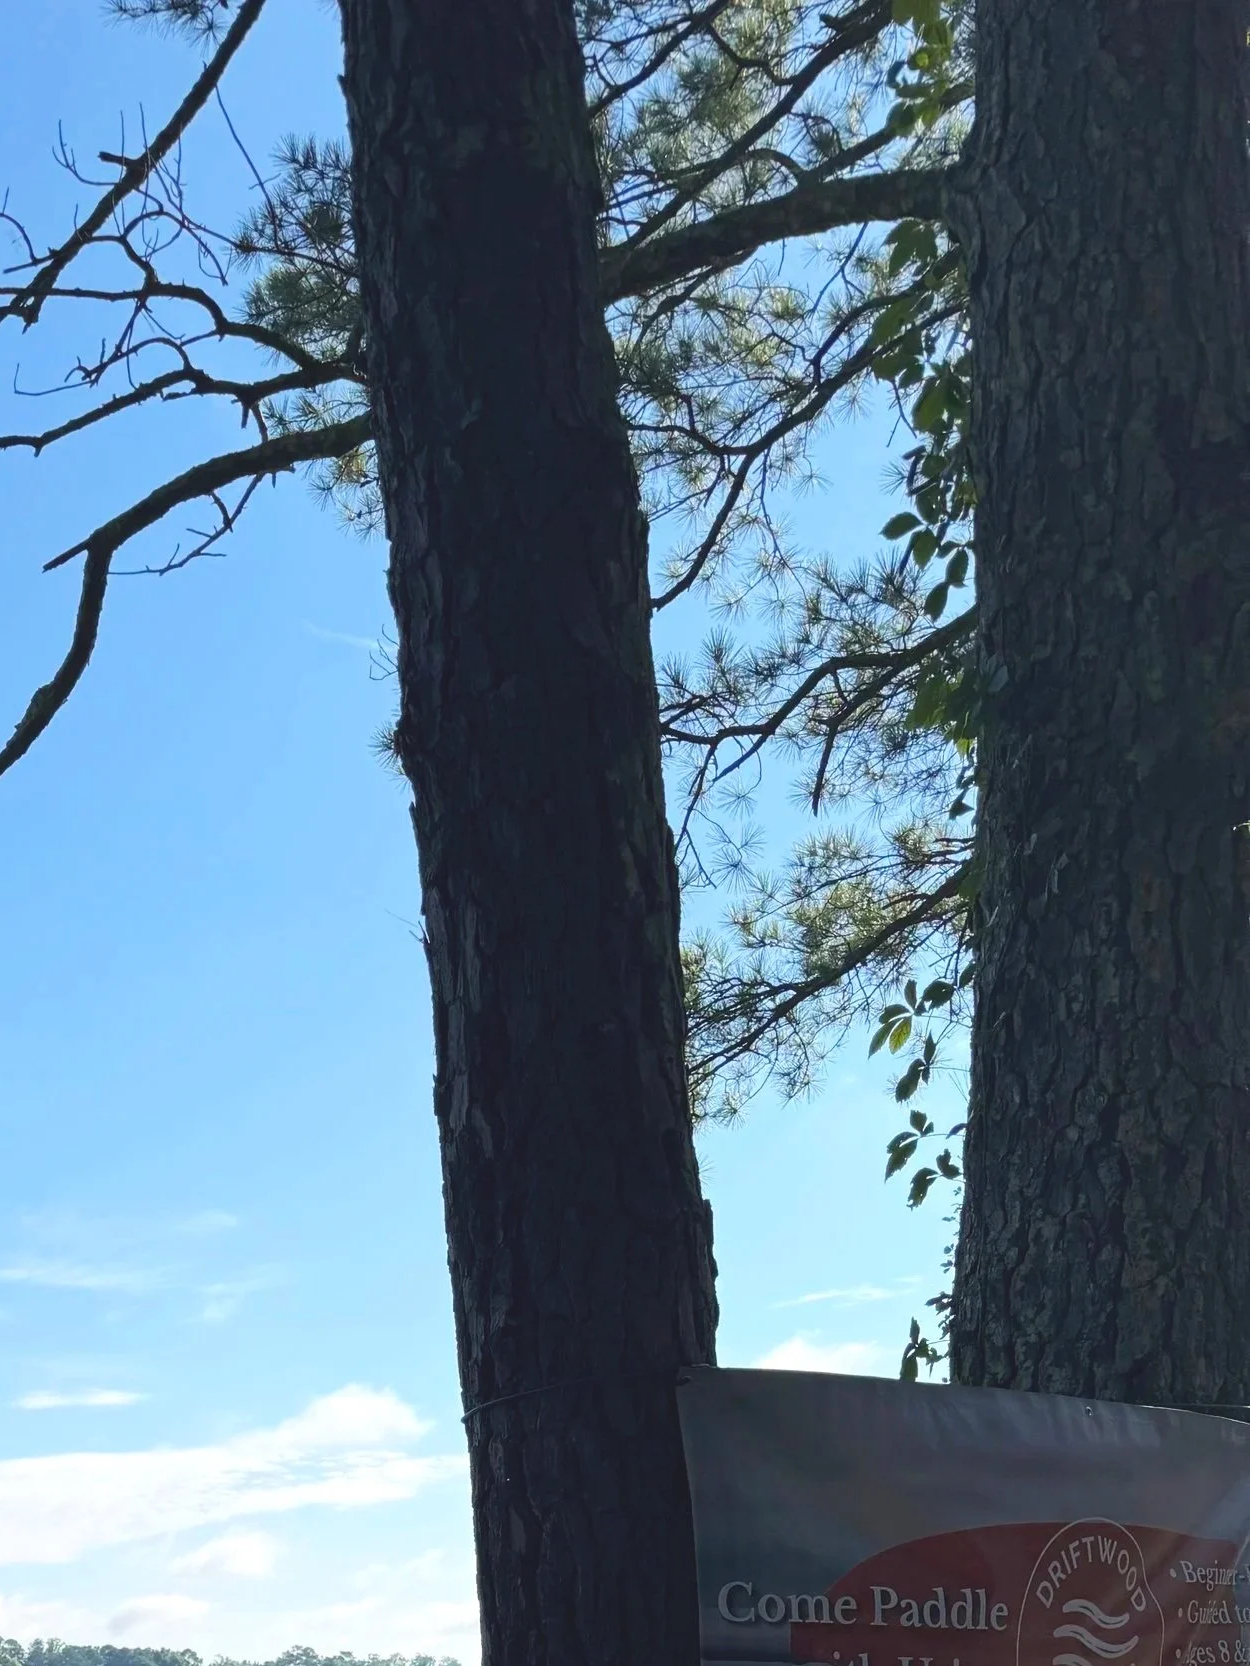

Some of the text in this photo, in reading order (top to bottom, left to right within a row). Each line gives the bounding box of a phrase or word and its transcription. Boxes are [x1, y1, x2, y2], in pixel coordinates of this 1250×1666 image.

[1036, 1536, 1146, 1611] DRIFTWOOD
[718, 1581, 1008, 1631] Come Paddle
[1217, 1640, 1230, 1663] 8
[1234, 1640, 1247, 1663] &
